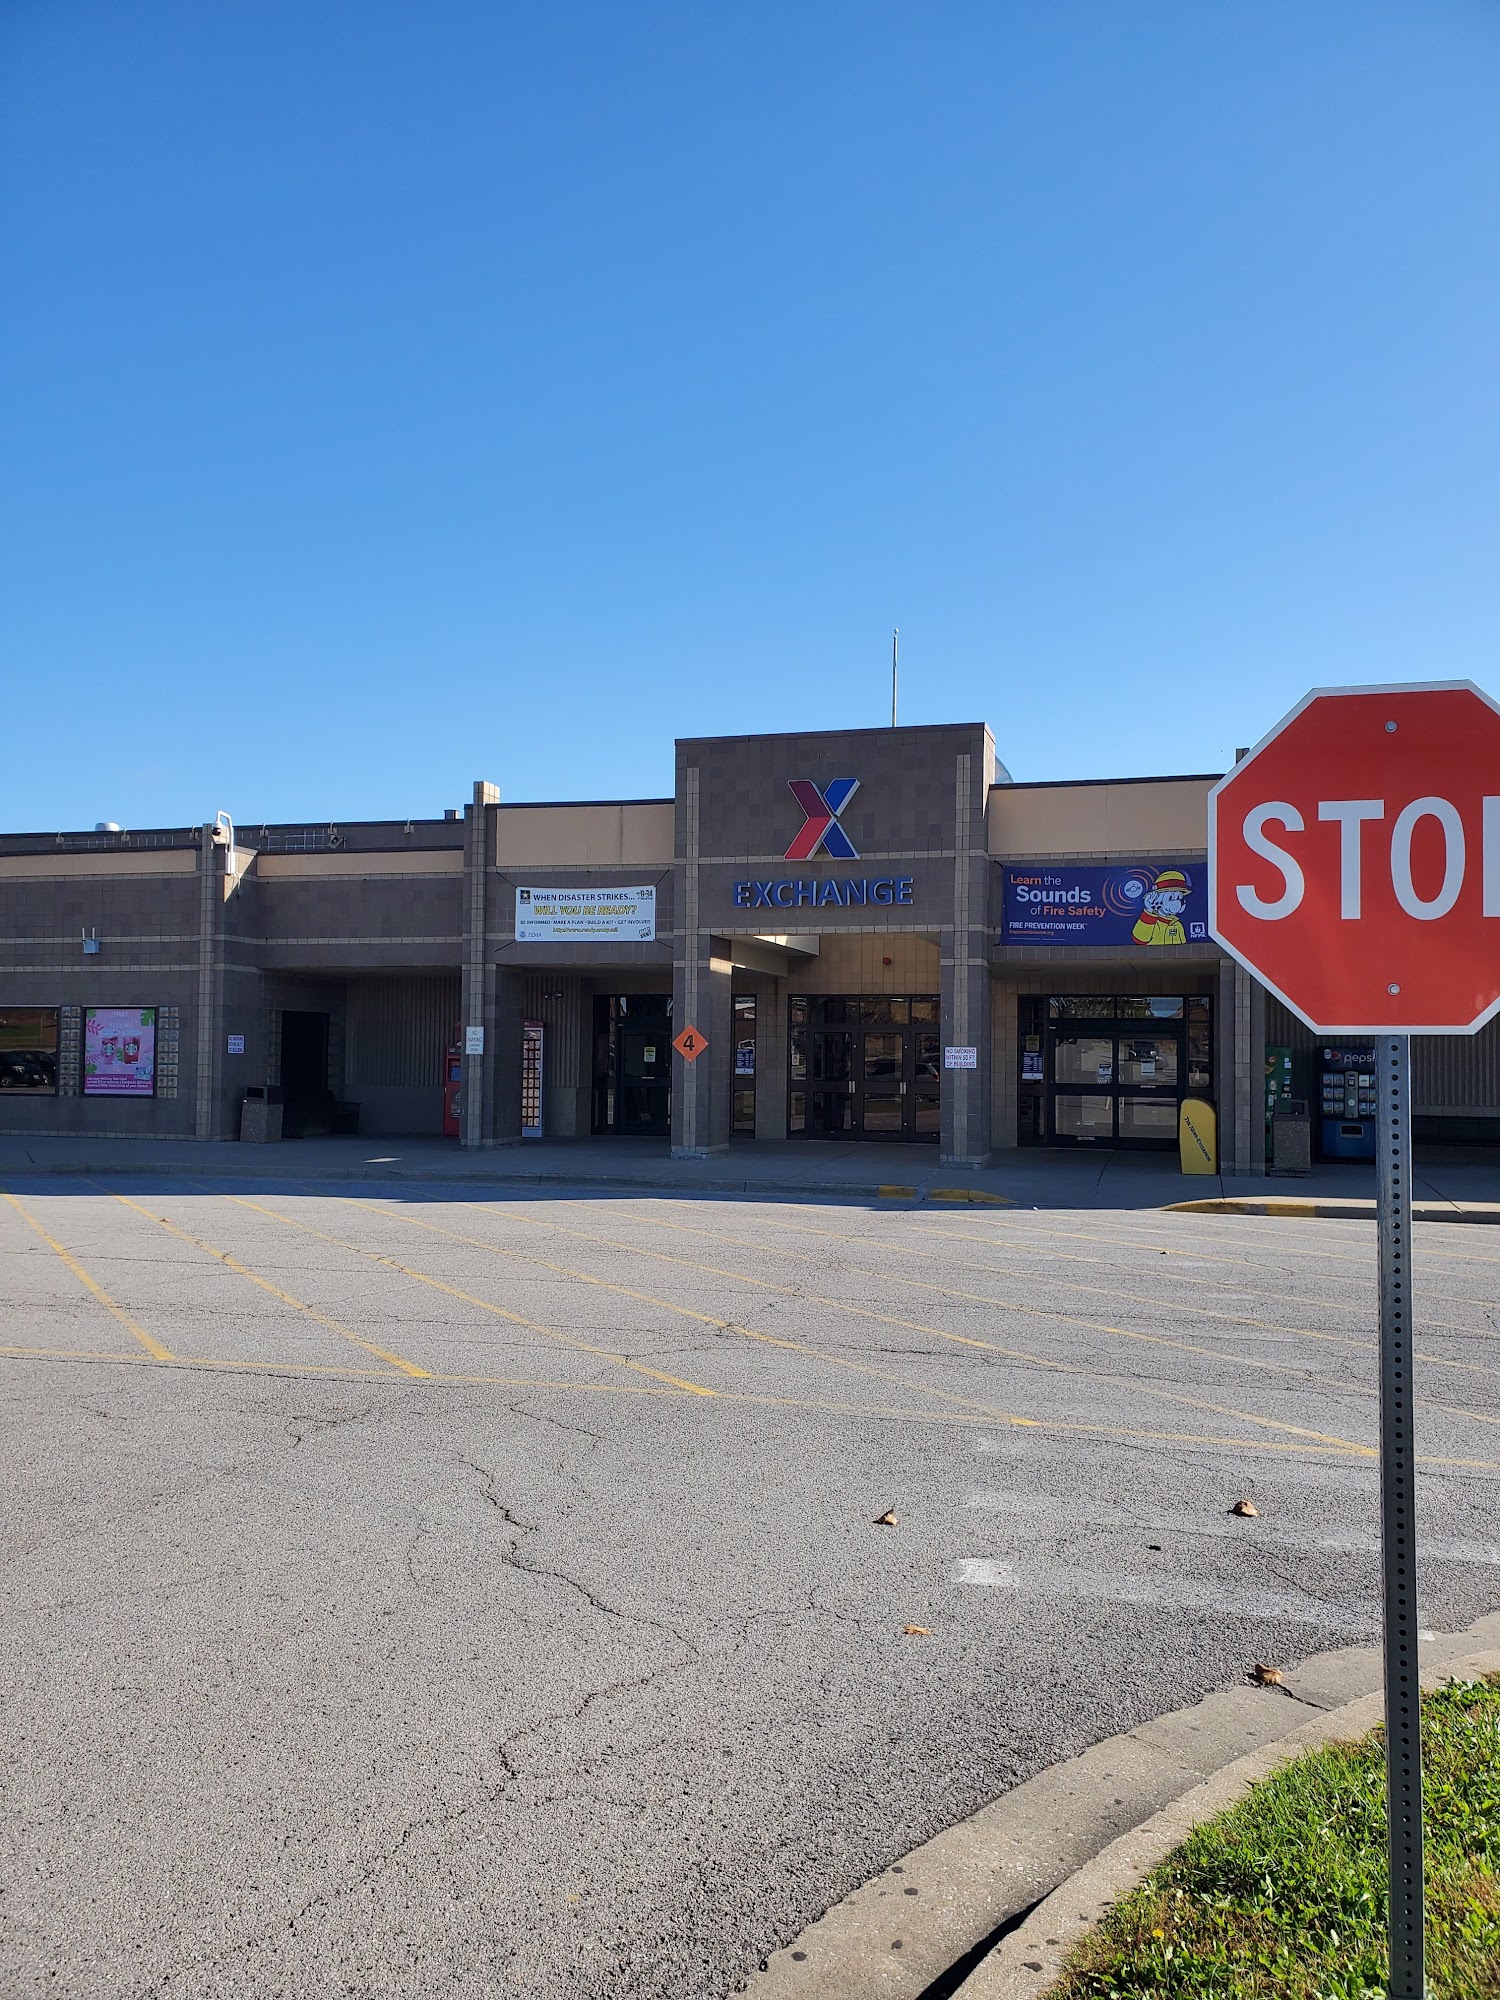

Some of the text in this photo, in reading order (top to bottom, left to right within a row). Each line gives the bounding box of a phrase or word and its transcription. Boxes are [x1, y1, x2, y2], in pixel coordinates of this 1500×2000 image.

[1236, 796, 1500, 921] STO
[1010, 874, 1062, 886] Learn the
[732, 877, 914, 908] EXCHANGE
[1016, 885, 1091, 903] Sounds
[534, 904, 637, 916] WILL YOU BE READY?
[1030, 905, 1106, 918] of Fire Safety
[1024, 922, 1065, 930] PREVENTION
[683, 1034, 695, 1051] 4
[1344, 1050, 1375, 1064] pepsi
